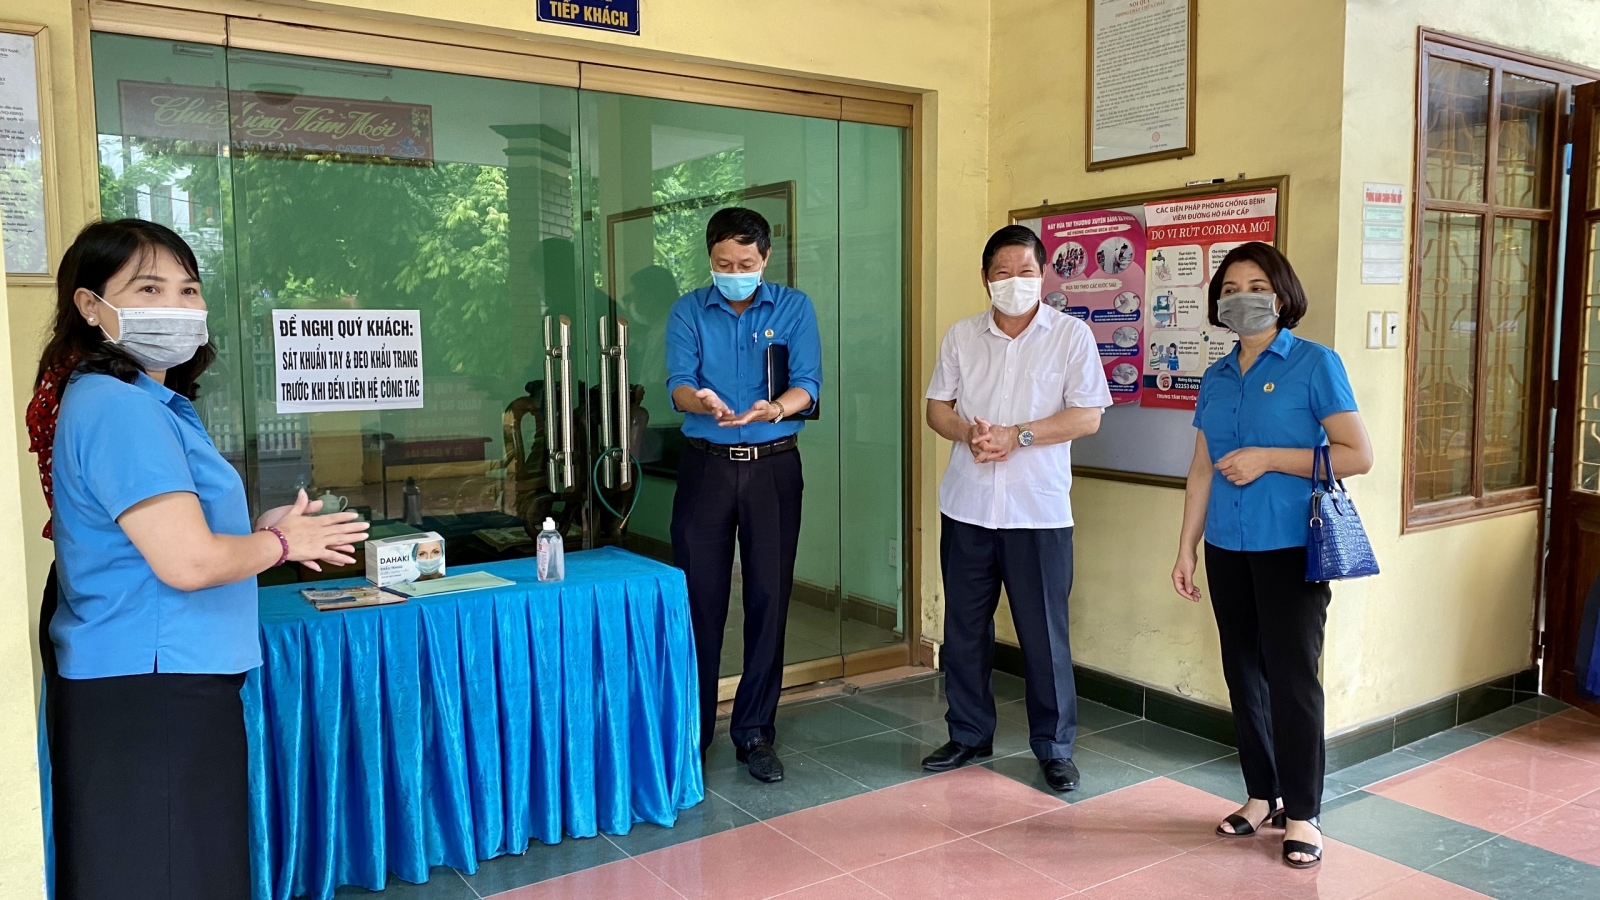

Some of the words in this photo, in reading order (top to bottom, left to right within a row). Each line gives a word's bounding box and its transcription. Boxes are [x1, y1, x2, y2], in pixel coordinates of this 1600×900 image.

[584, 5, 629, 27] KHÁCH
[284, 105, 346, 133] Năm
[259, 141, 298, 152] YEAR
[1155, 205, 1169, 214] CÁC
[1169, 204, 1184, 214] BIỆN
[1185, 202, 1201, 211] PHÁP
[1201, 201, 1224, 210] PHÒNG
[1225, 197, 1248, 208] CHỐNG
[1249, 197, 1266, 207] BỆNH
[1172, 211, 1187, 221] VIÊM
[1187, 210, 1210, 220] ĐƯỜNG
[1211, 209, 1221, 218] HÔ
[1221, 208, 1235, 217] HẤP
[1236, 207, 1250, 216] CẤP
[1151, 229, 1165, 240] DO
[1167, 228, 1177, 239] VI
[1179, 225, 1200, 238] RÚT
[1201, 223, 1247, 236] CORONA
[1249, 218, 1270, 233] MỚI
[280, 314, 297, 337] ĐỀ
[301, 320, 334, 340] NGHỊ
[338, 317, 363, 338] QUÝ
[367, 317, 413, 336] KHÁCH:
[282, 347, 297, 370] SÁT
[300, 343, 327, 370] KHUẨN
[329, 351, 343, 370] TAY
[345, 351, 351, 369] &
[353, 350, 368, 369] ĐEO
[371, 343, 391, 369] KHẨU
[393, 350, 418, 368] TRANG
[281, 376, 309, 401] TRƯỚC
[311, 382, 326, 400] KHI
[328, 375, 345, 400] ĐẾN
[347, 377, 366, 399] LIÊN
[368, 376, 378, 402] HỆ
[380, 376, 403, 398] CÔNG
[405, 376, 420, 397] TÁC
[380, 555, 410, 565] DAHAKI
